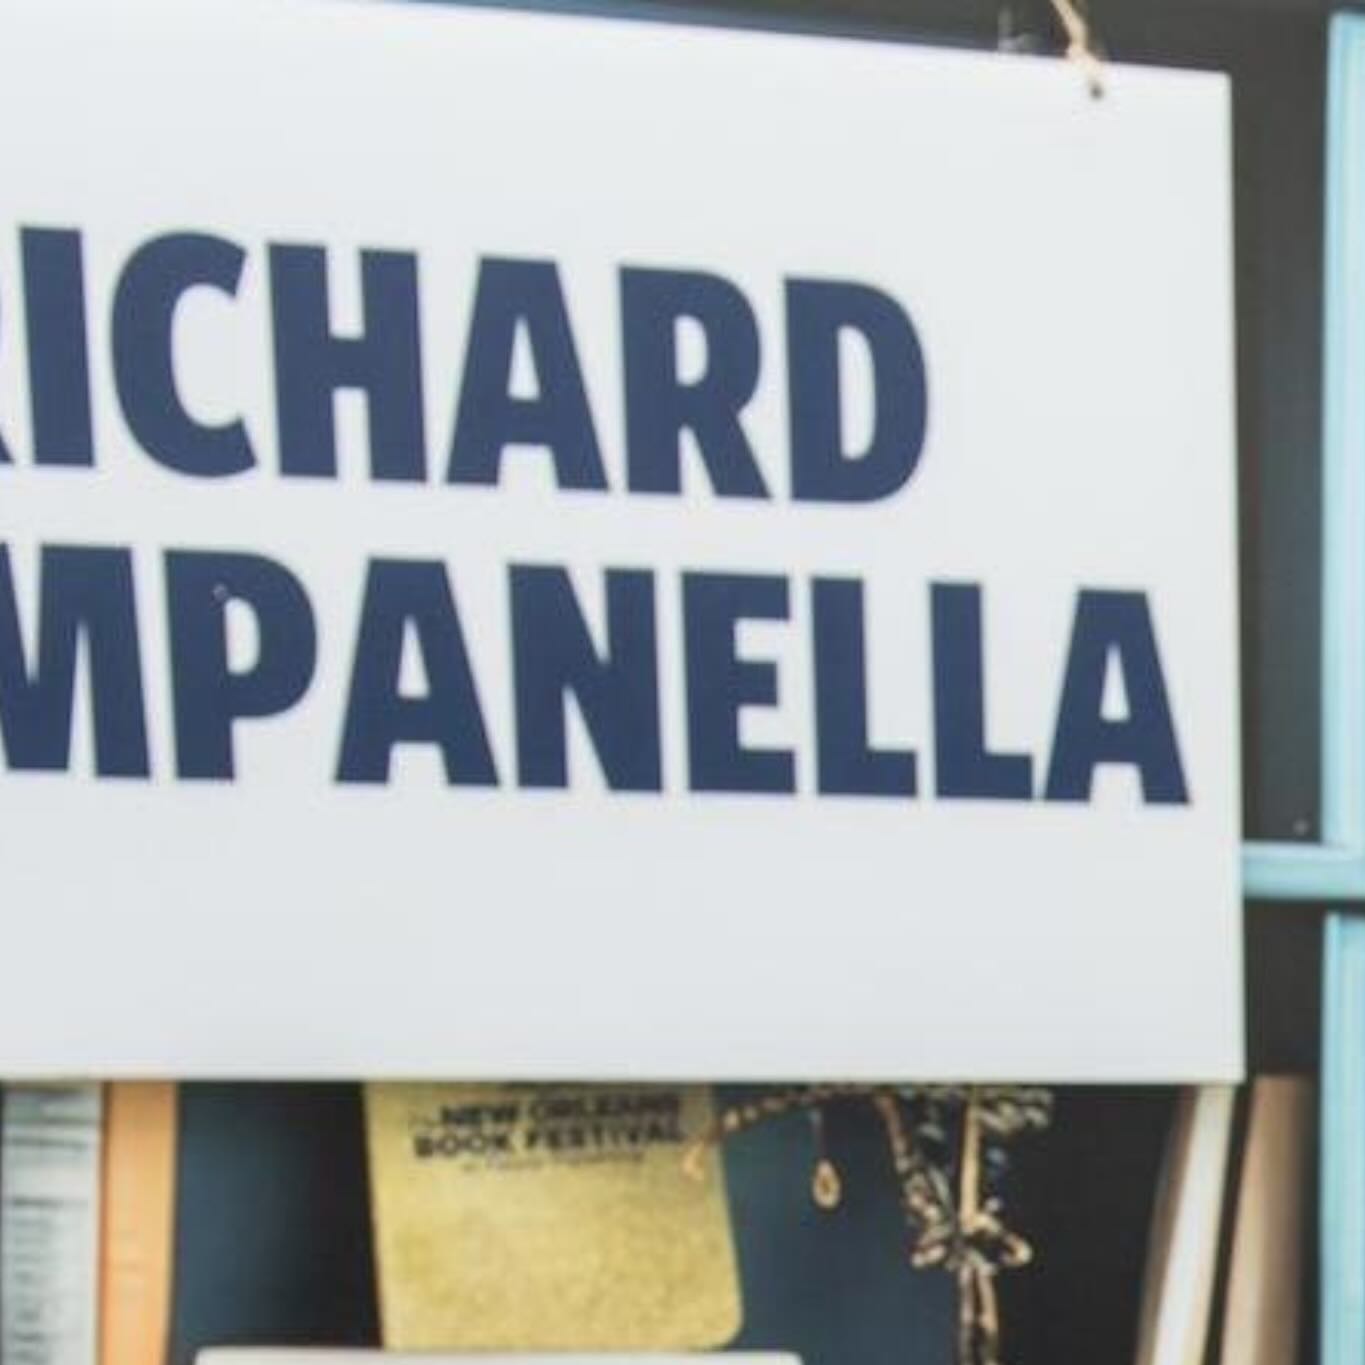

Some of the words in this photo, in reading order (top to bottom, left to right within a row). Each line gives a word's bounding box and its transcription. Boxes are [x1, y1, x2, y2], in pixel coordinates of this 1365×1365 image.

[0, 224, 929, 505] ICHARD
[414, 1132, 514, 1157] BOOK
[525, 1123, 684, 1150] FESTIVAL
